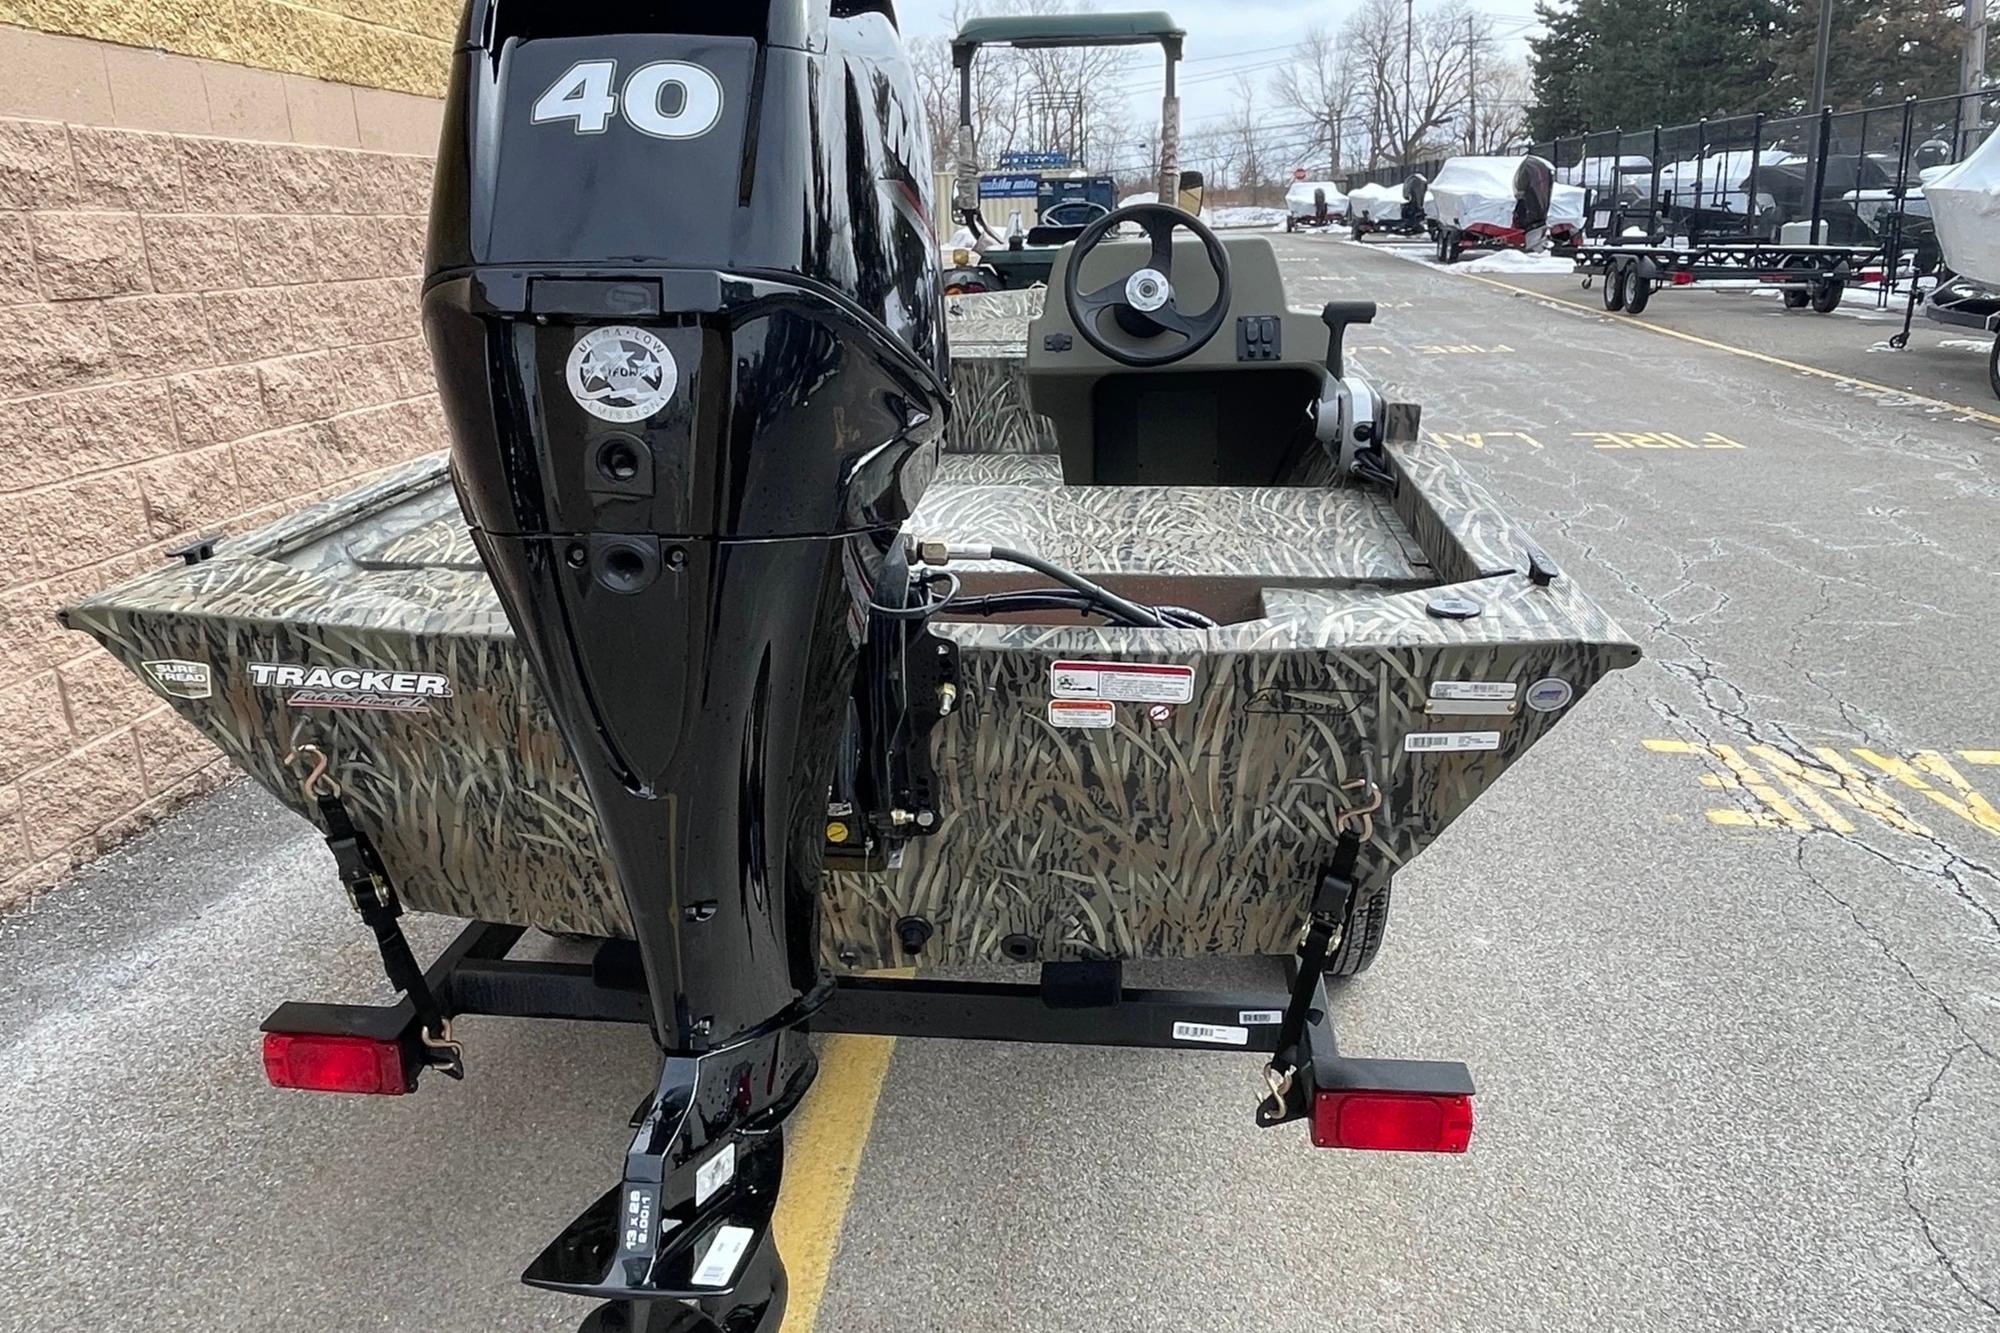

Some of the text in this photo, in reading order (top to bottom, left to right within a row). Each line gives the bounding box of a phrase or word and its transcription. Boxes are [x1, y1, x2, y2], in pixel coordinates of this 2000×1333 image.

[531, 59, 723, 140] 40
[634, 331, 665, 354] LOW
[1570, 431, 1747, 448] FIRE
[154, 664, 198, 674] SURE
[155, 672, 207, 683] TREAD
[248, 662, 452, 697] TRACKER
[626, 1229, 638, 1250] 13
